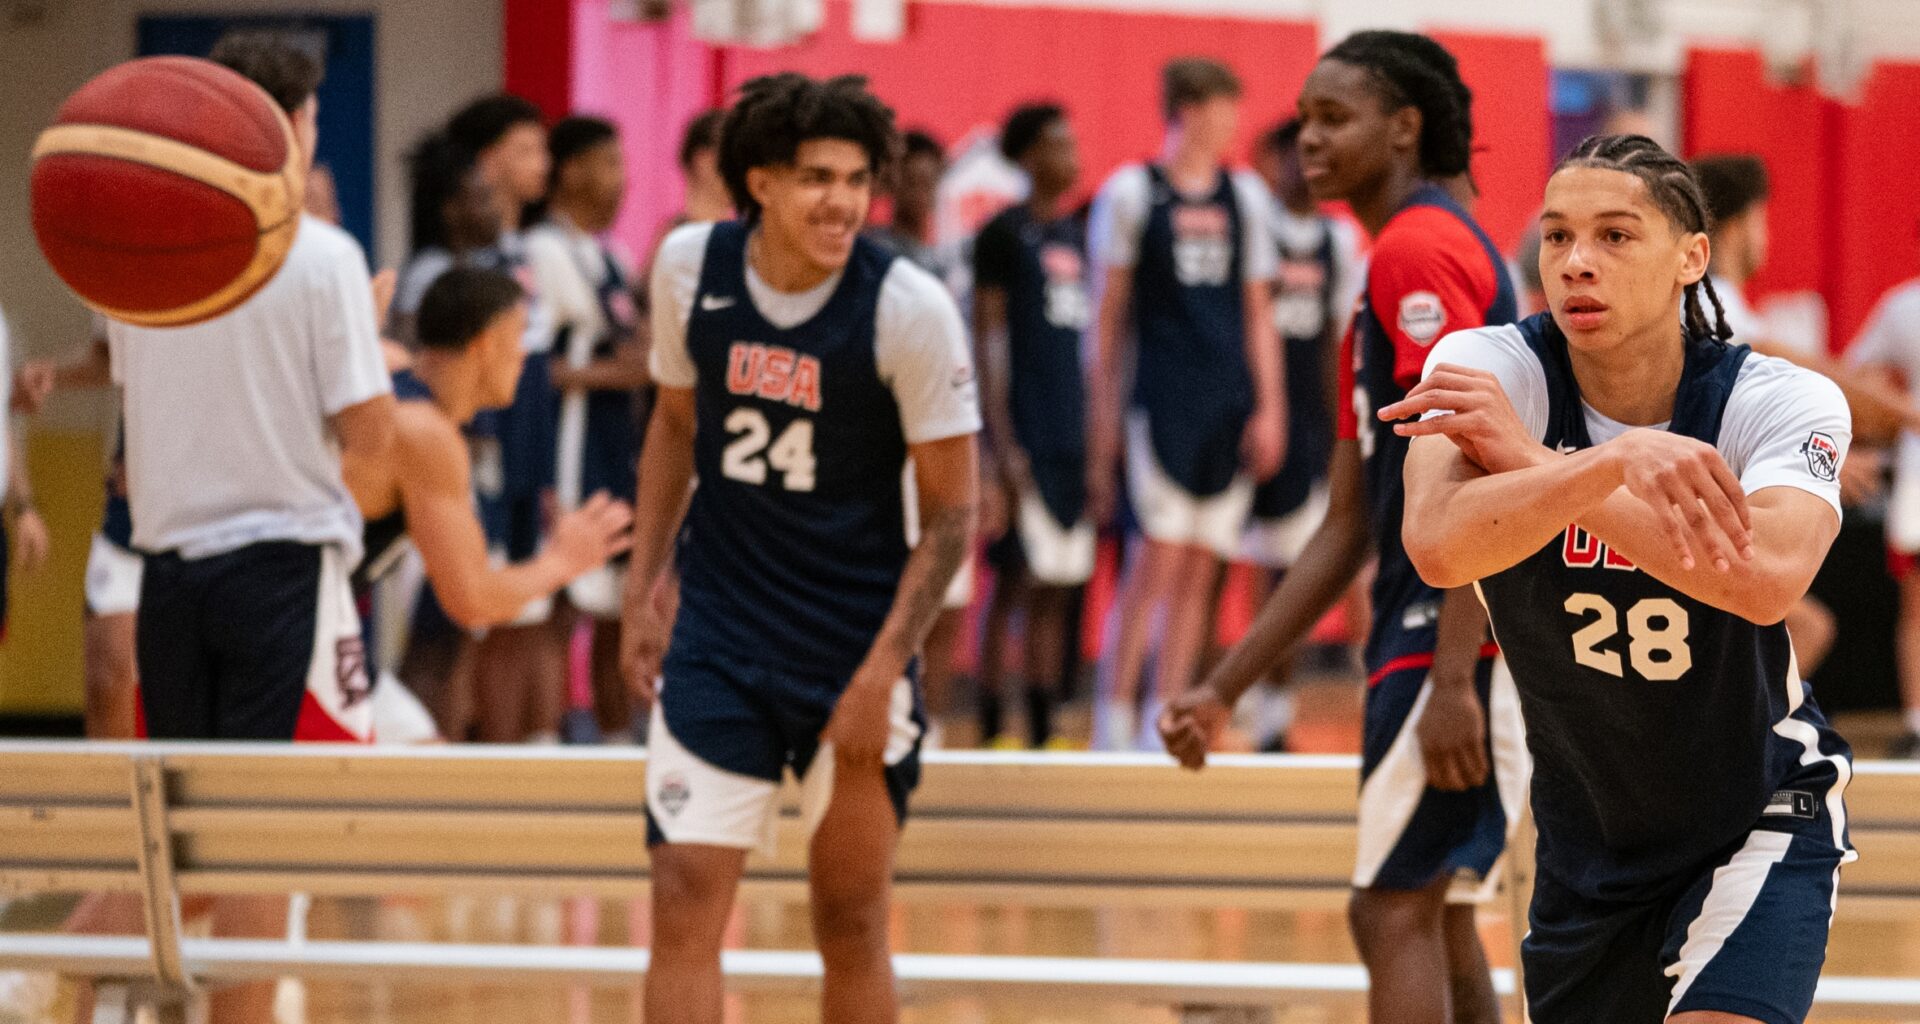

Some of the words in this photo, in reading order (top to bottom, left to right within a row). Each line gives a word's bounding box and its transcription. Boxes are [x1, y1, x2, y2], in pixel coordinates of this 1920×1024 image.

[727, 341, 822, 412] USA
[722, 406, 816, 492] 24
[1564, 593, 1692, 681] 28
[1800, 798, 1807, 811] L
